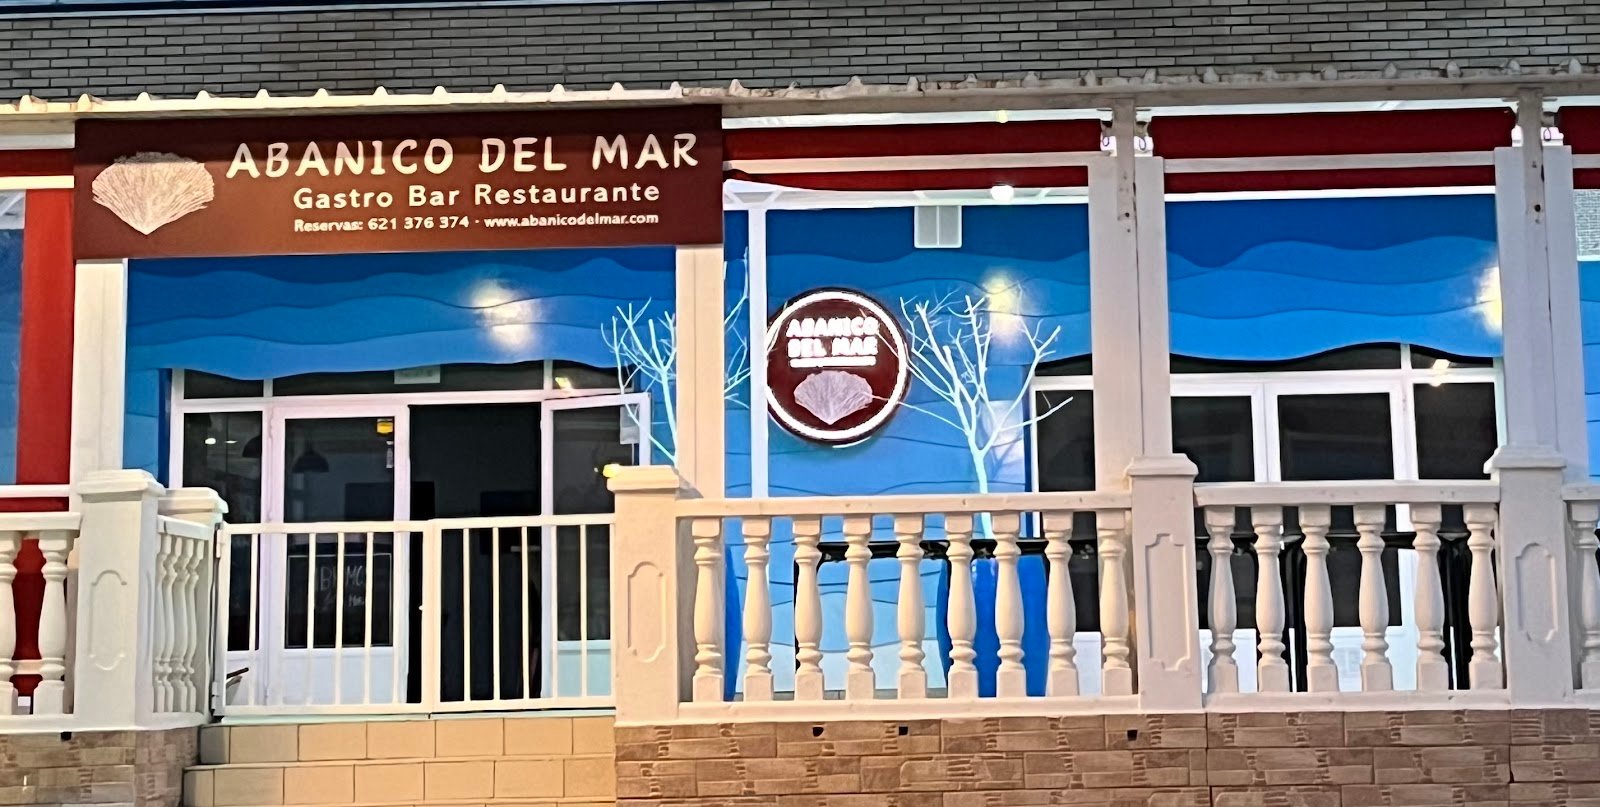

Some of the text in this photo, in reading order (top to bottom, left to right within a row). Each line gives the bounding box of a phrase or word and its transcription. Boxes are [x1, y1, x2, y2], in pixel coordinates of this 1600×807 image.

[226, 133, 699, 178] ABANICO DEL MAR
[293, 182, 660, 209] Gastro Bar Restaurante
[293, 218, 364, 232] Reservas:
[368, 217, 397, 230] 621
[404, 216, 434, 229] 376
[439, 215, 470, 228] 374
[484, 213, 660, 228] www.abanicodelmar.com
[786, 316, 879, 337] ABANICO
